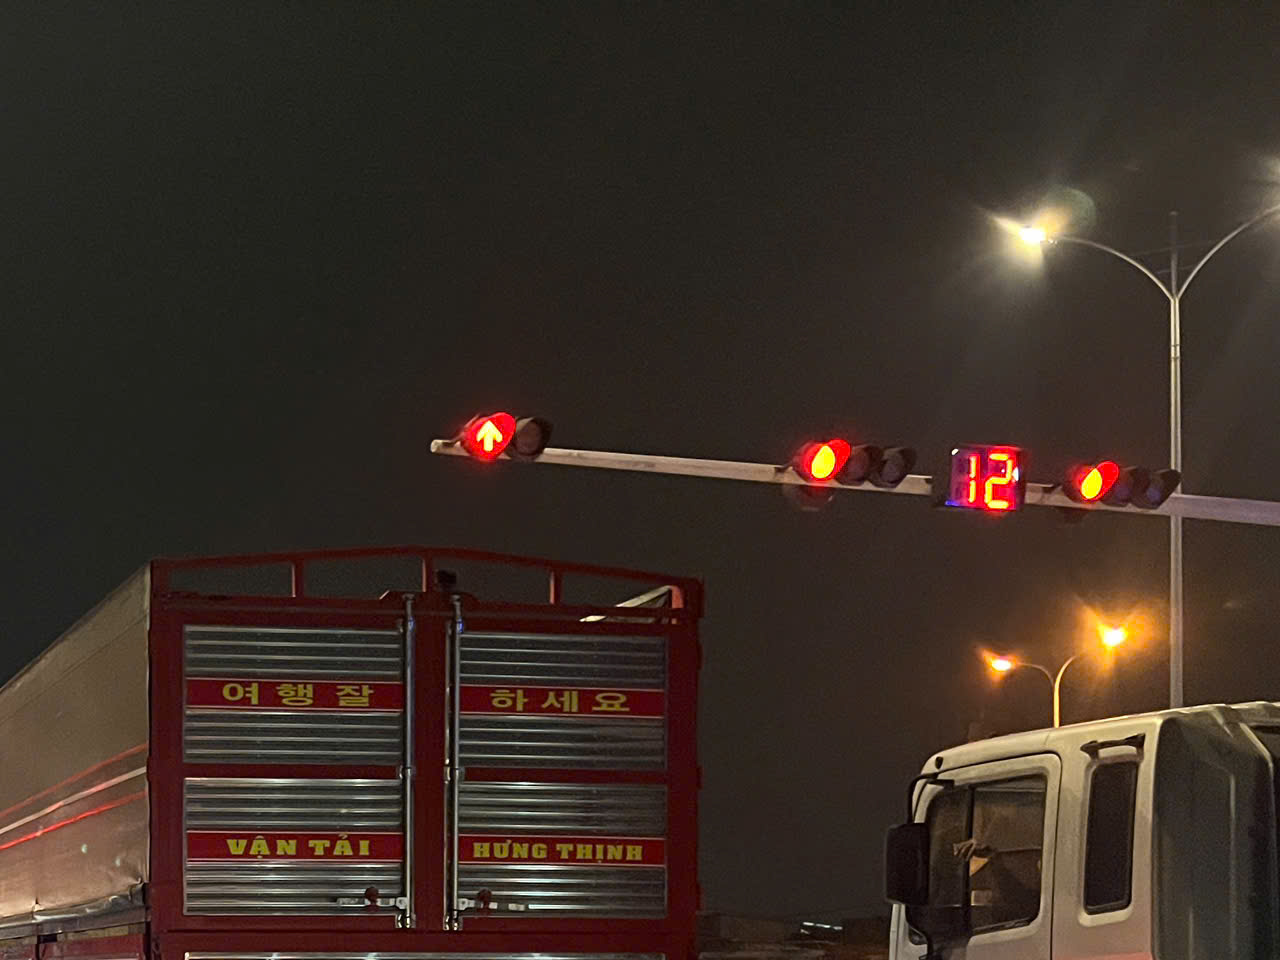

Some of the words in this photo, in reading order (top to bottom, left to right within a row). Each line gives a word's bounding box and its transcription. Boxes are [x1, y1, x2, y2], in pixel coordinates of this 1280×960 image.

[968, 452, 1013, 510] 12
[225, 834, 297, 859] VẬN
[307, 832, 370, 856] TẢI
[472, 839, 549, 859] HƯNG
[555, 843, 644, 864] THỊNH
